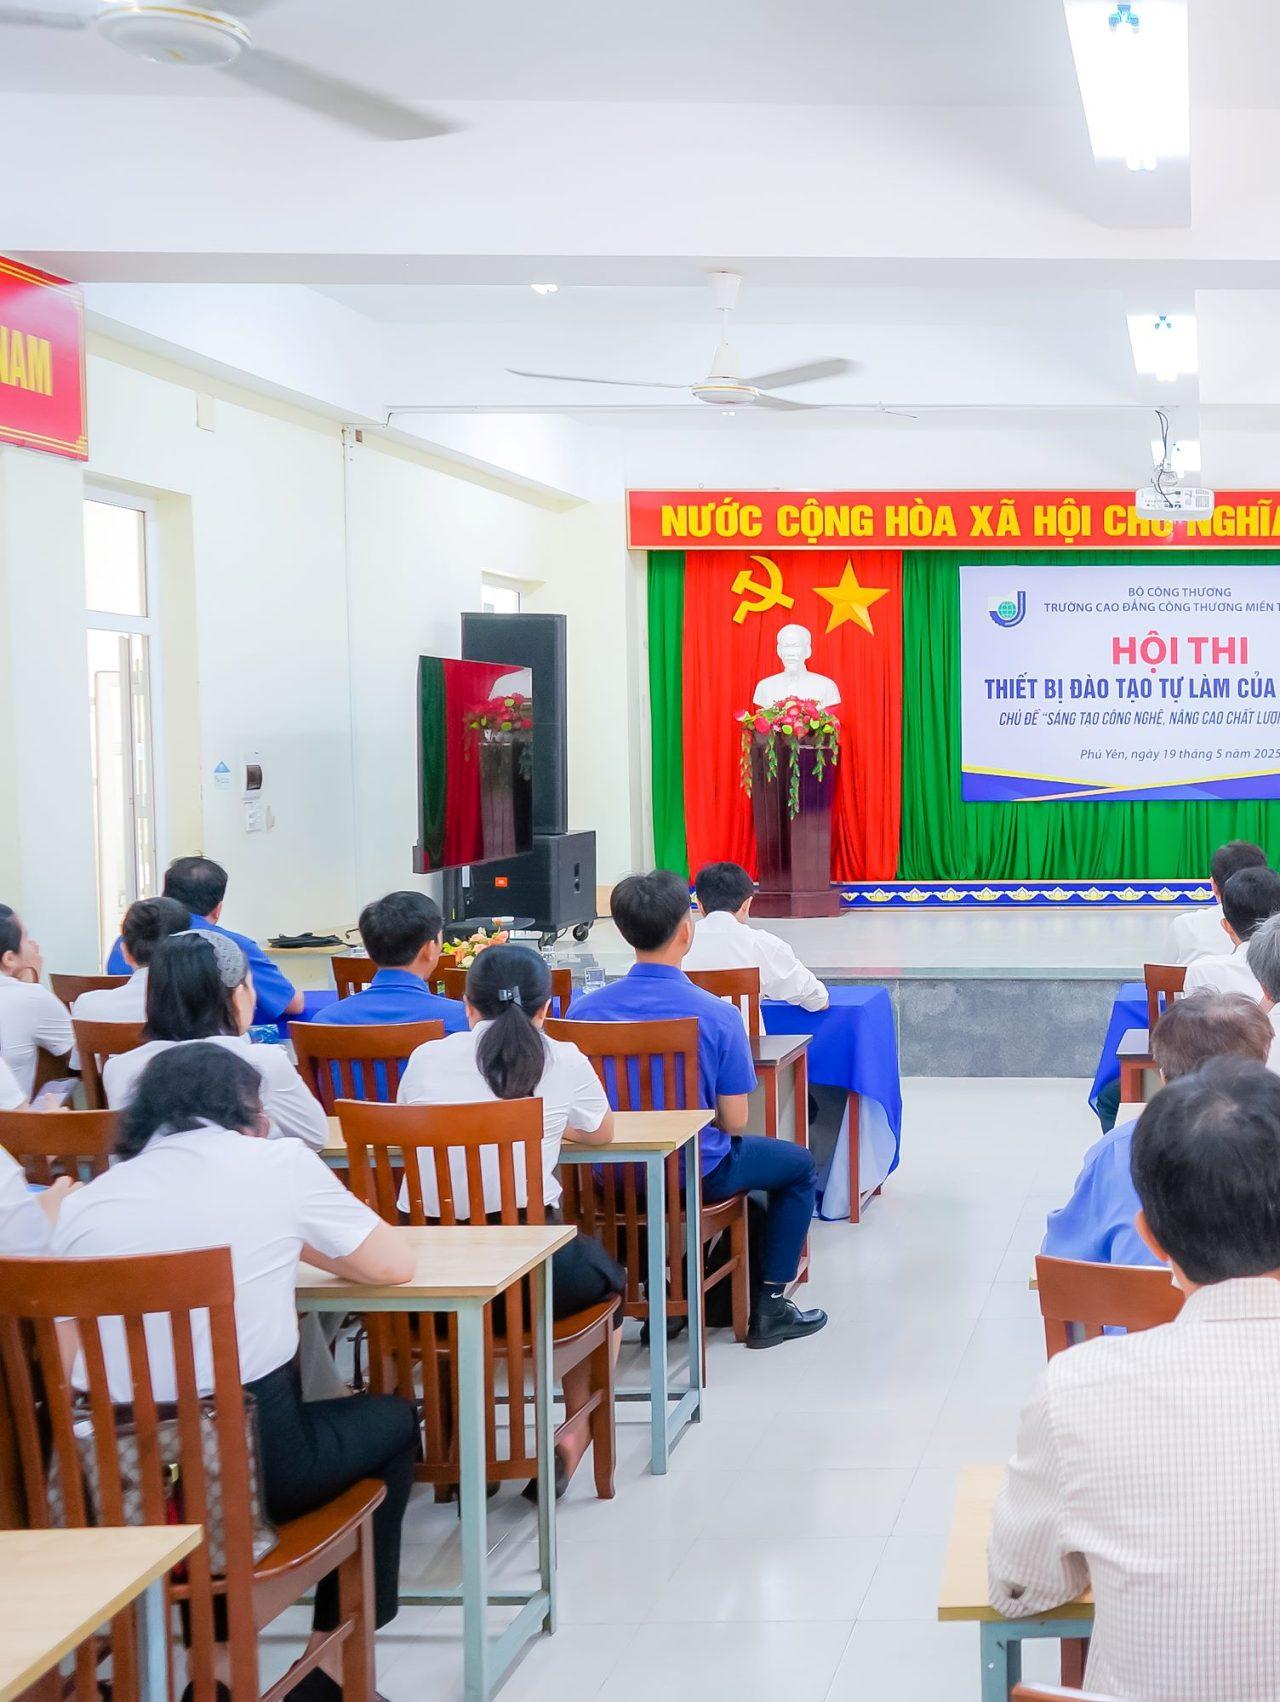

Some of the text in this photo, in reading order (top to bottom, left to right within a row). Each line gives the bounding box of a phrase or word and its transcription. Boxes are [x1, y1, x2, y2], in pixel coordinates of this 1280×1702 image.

[661, 497, 763, 537] NƯỚC
[777, 498, 874, 544] CỘNG
[885, 498, 957, 537] HÒA
[970, 498, 1021, 537] XÃ
[1034, 498, 1091, 544] HỘI
[1128, 586, 1145, 599] BỘ
[1147, 586, 1180, 597] CÔNG
[1095, 602, 1120, 612] CAO
[1158, 600, 1191, 612] CÔNG
[1112, 630, 1248, 674] HỘI THI
[984, 671, 1038, 699] THIẾT
[1044, 678, 1064, 704] BỊ
[1069, 673, 1110, 699] ĐÀO
[1115, 678, 1153, 703] TẠO
[1158, 675, 1185, 703] TỰ
[1189, 673, 1231, 699] LÀM
[1237, 670, 1277, 699] CỦA
[1102, 709, 1132, 726] CÔNG
[1168, 709, 1200, 725] NÂNG
[1202, 710, 1224, 725] CAO
[1080, 749, 1102, 760] Phú
[1105, 749, 1128, 762] Yên,
[1131, 749, 1160, 762] ngày
[1163, 749, 1177, 760] 19
[1179, 749, 1213, 762] tháng
[1215, 749, 1223, 760] 5
[1225, 749, 1251, 759] năm
